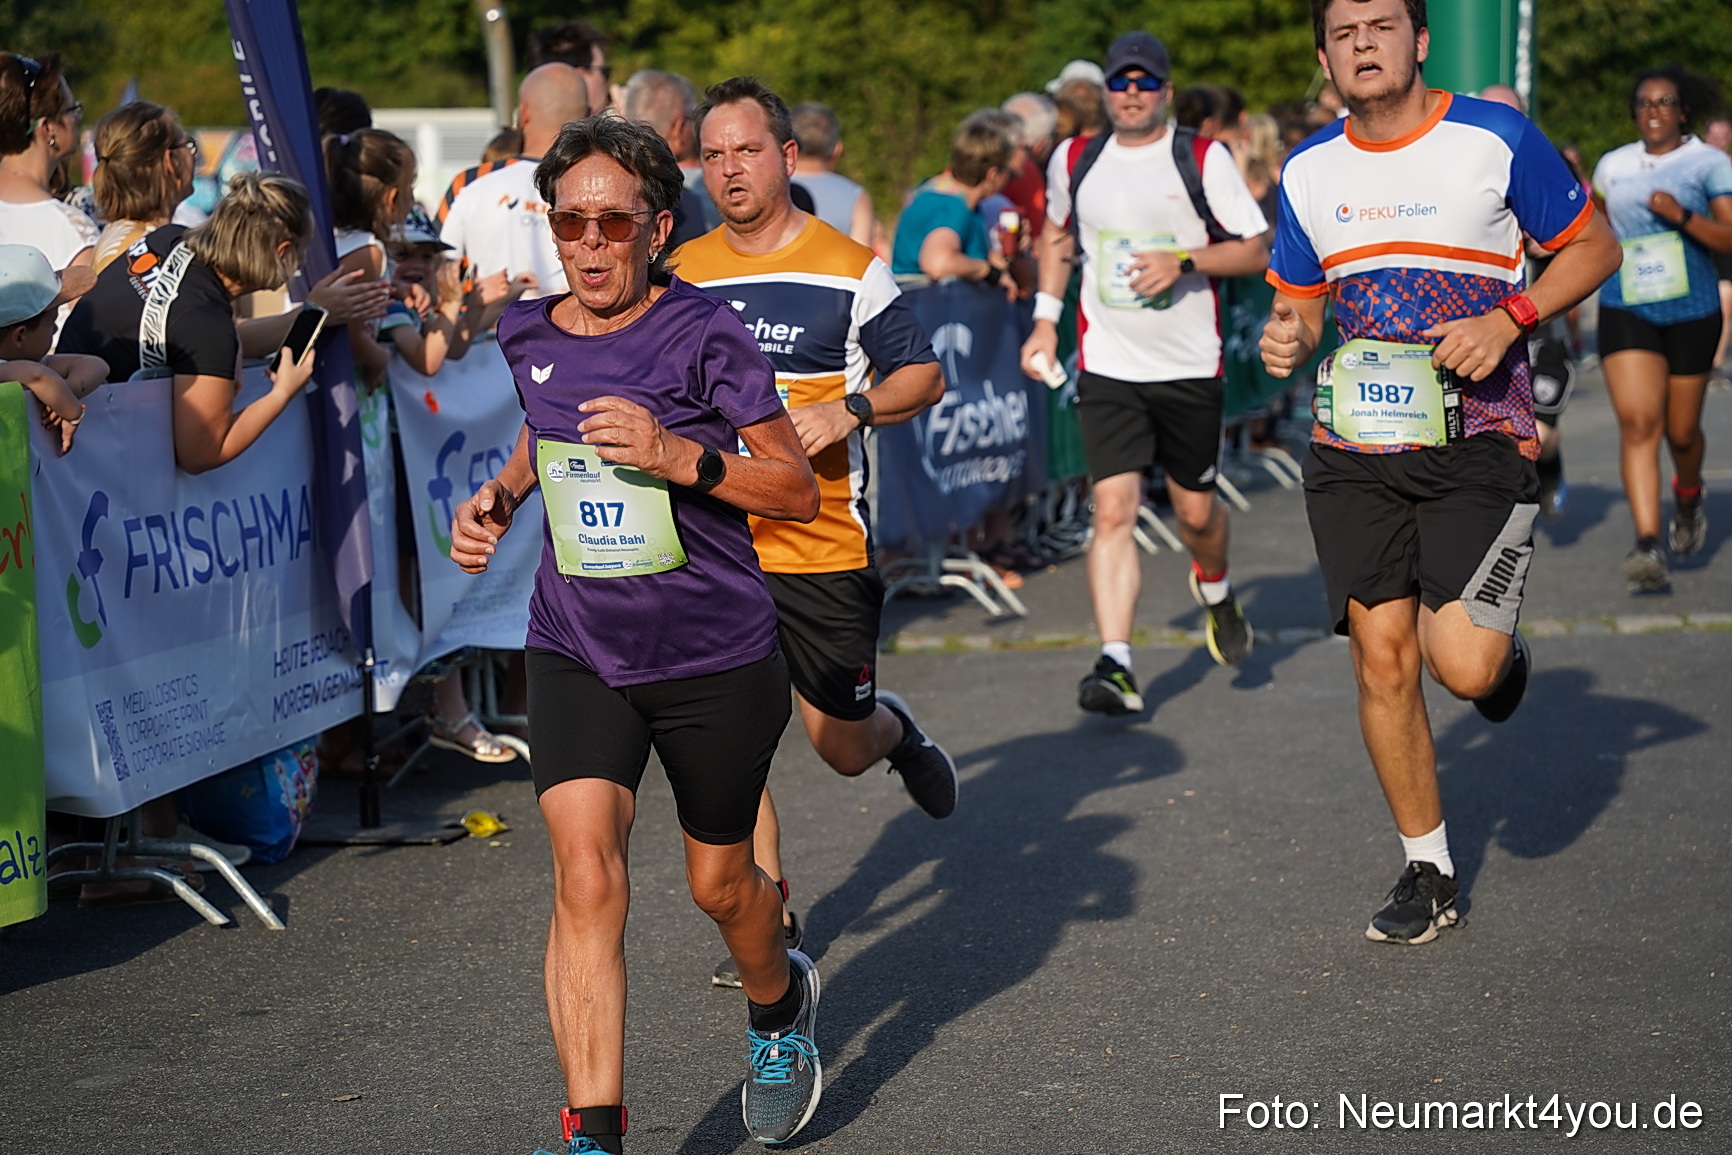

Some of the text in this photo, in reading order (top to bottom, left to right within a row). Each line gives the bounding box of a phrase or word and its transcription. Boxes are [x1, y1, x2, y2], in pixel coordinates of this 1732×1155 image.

[1359, 203, 1437, 221] PEKUFolien
[1358, 382, 1414, 405] 1987
[1350, 408, 1428, 420] Jonah Helmreich
[566, 471, 601, 479] Firmenlauf
[579, 500, 625, 528] 817
[578, 533, 646, 546] Claudia Bahl
[1474, 547, 1522, 608] PUMA
[272, 640, 309, 679] HEUTE
[272, 680, 321, 723] MORGEN
[125, 698, 209, 745] CORPORATE PRINT
[131, 721, 226, 774] CORPORATE SIGNAGE
